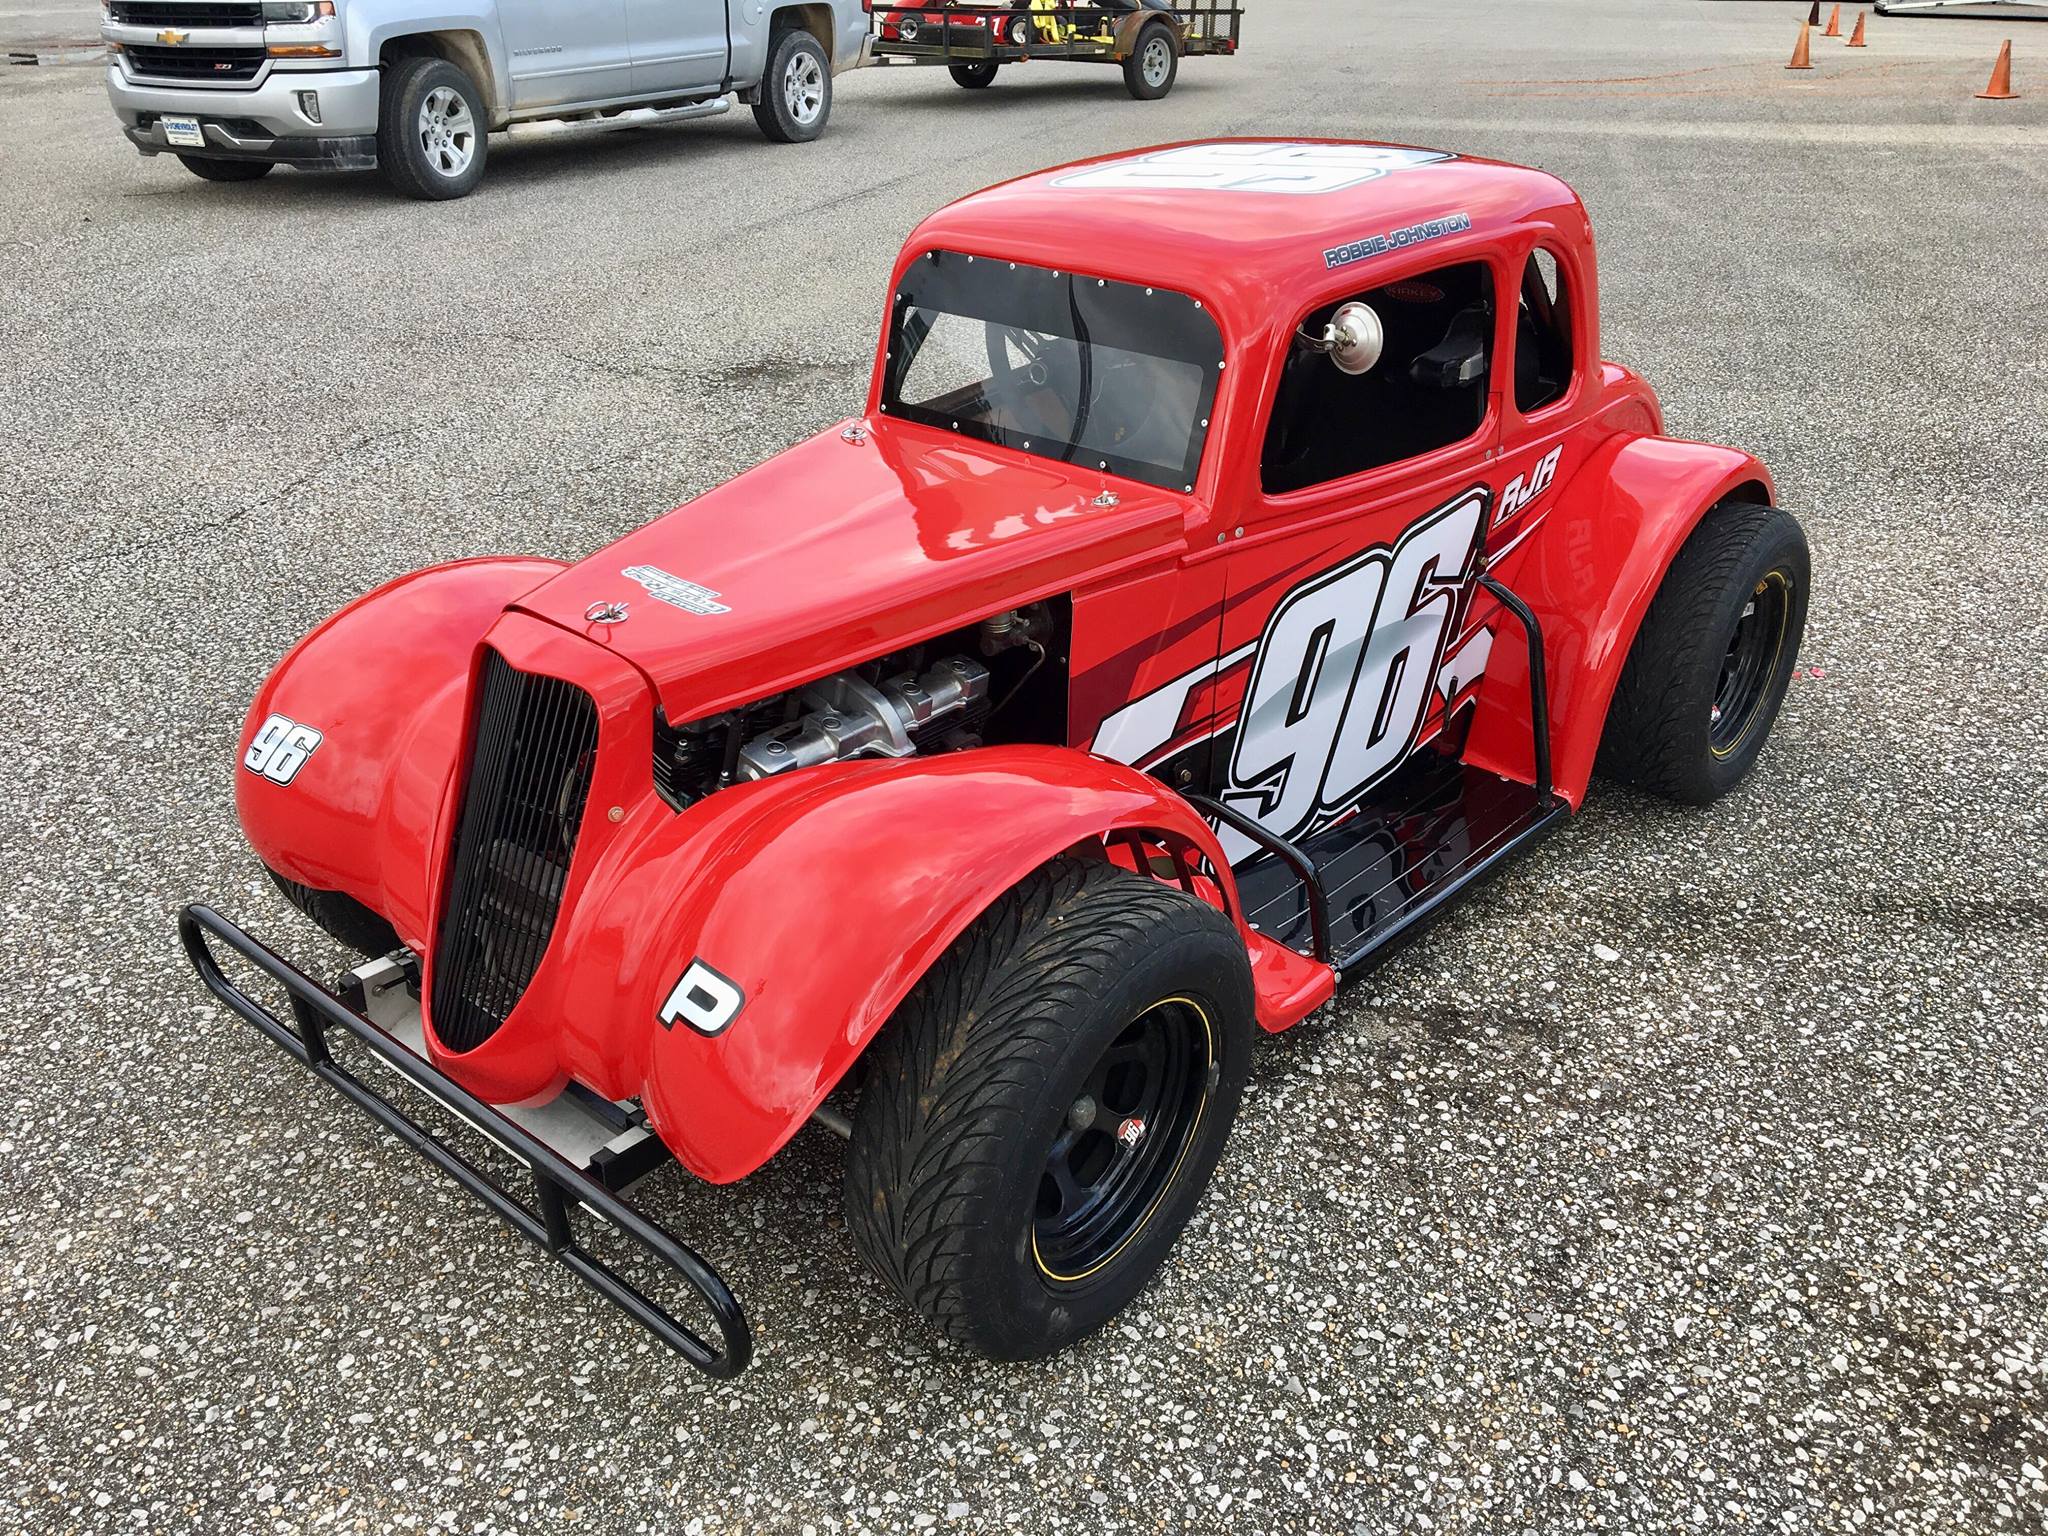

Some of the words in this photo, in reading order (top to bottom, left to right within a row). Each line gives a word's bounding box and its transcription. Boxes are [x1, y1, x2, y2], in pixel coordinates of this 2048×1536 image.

[1323, 235, 1388, 268] ROBBIE
[1386, 213, 1471, 250] JOHNSTON
[1494, 443, 1563, 524] RJR
[1214, 483, 1490, 868] 96
[243, 712, 324, 787] 96
[656, 955, 745, 1037] P
[1124, 1121, 1140, 1146] 96
